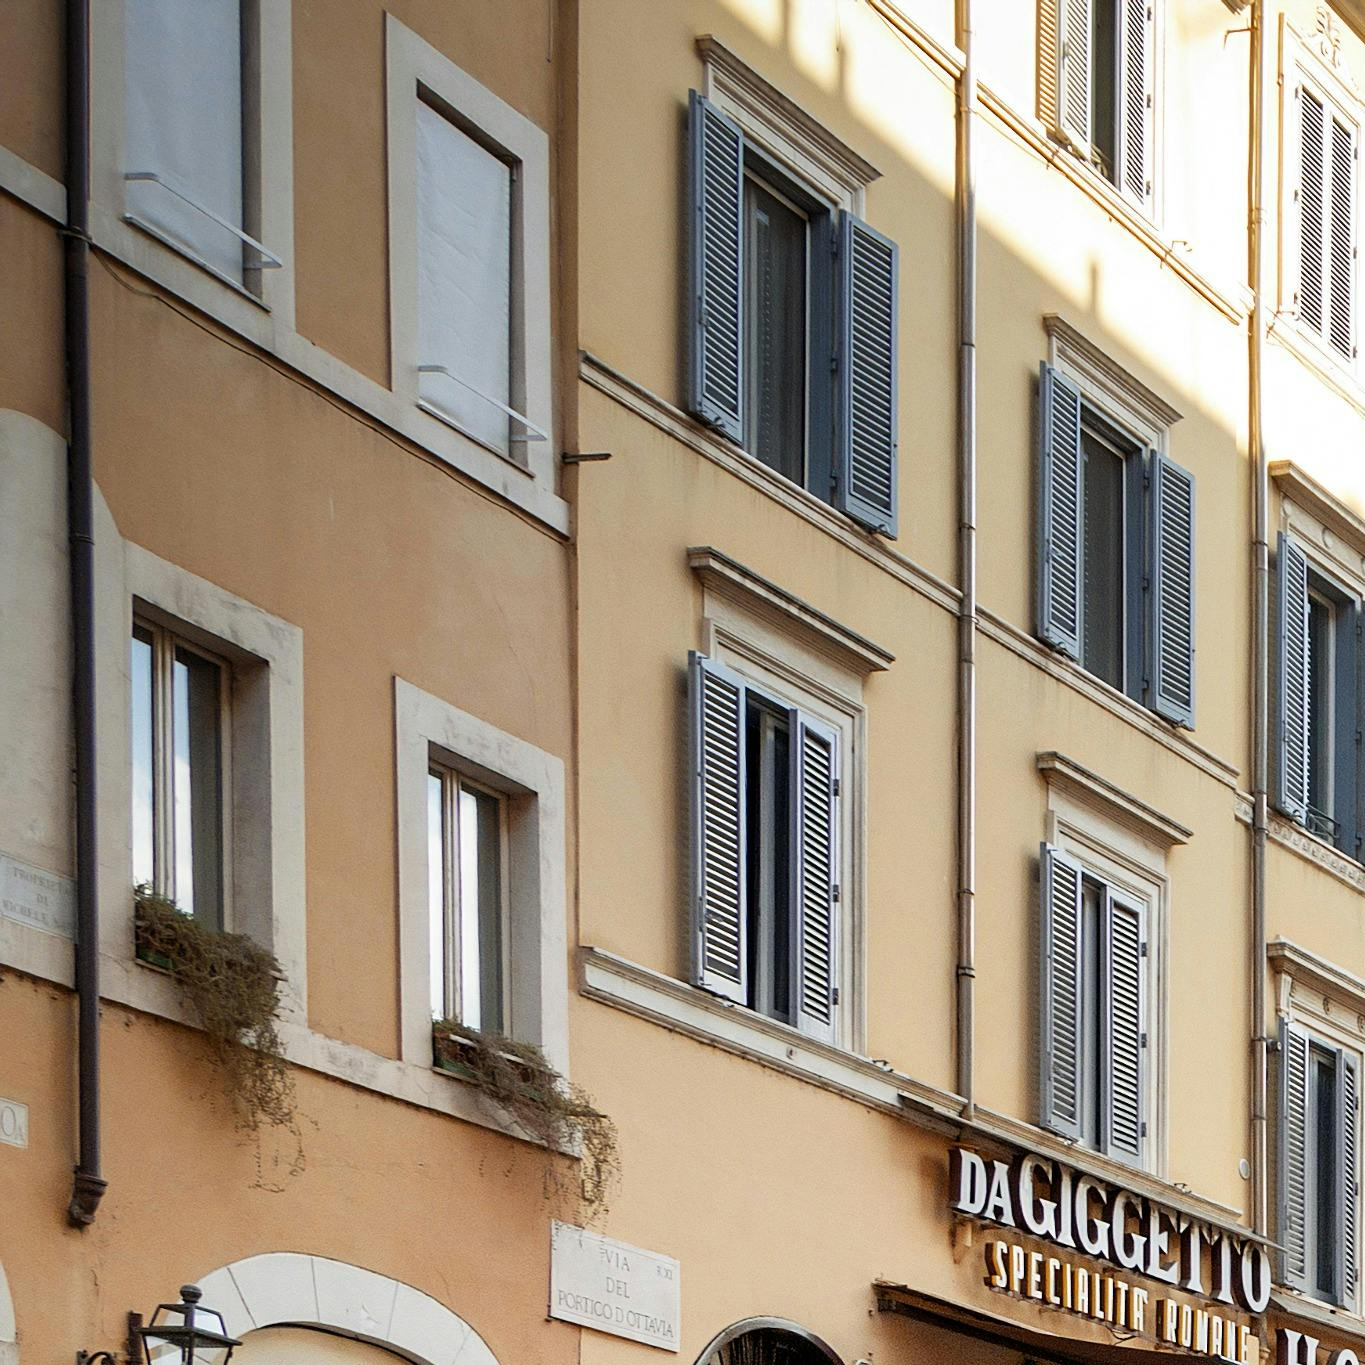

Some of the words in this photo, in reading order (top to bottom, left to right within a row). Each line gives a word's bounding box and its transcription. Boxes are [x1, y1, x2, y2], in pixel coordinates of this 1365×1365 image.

[956, 1148, 1016, 1227] DA
[1018, 1153, 1272, 1314] GIGGETTO
[604, 1249, 631, 1272] VIA
[606, 1277, 631, 1299] DEL
[558, 1290, 613, 1320] PORTICO
[1163, 1298, 1251, 1364] ROMANE
